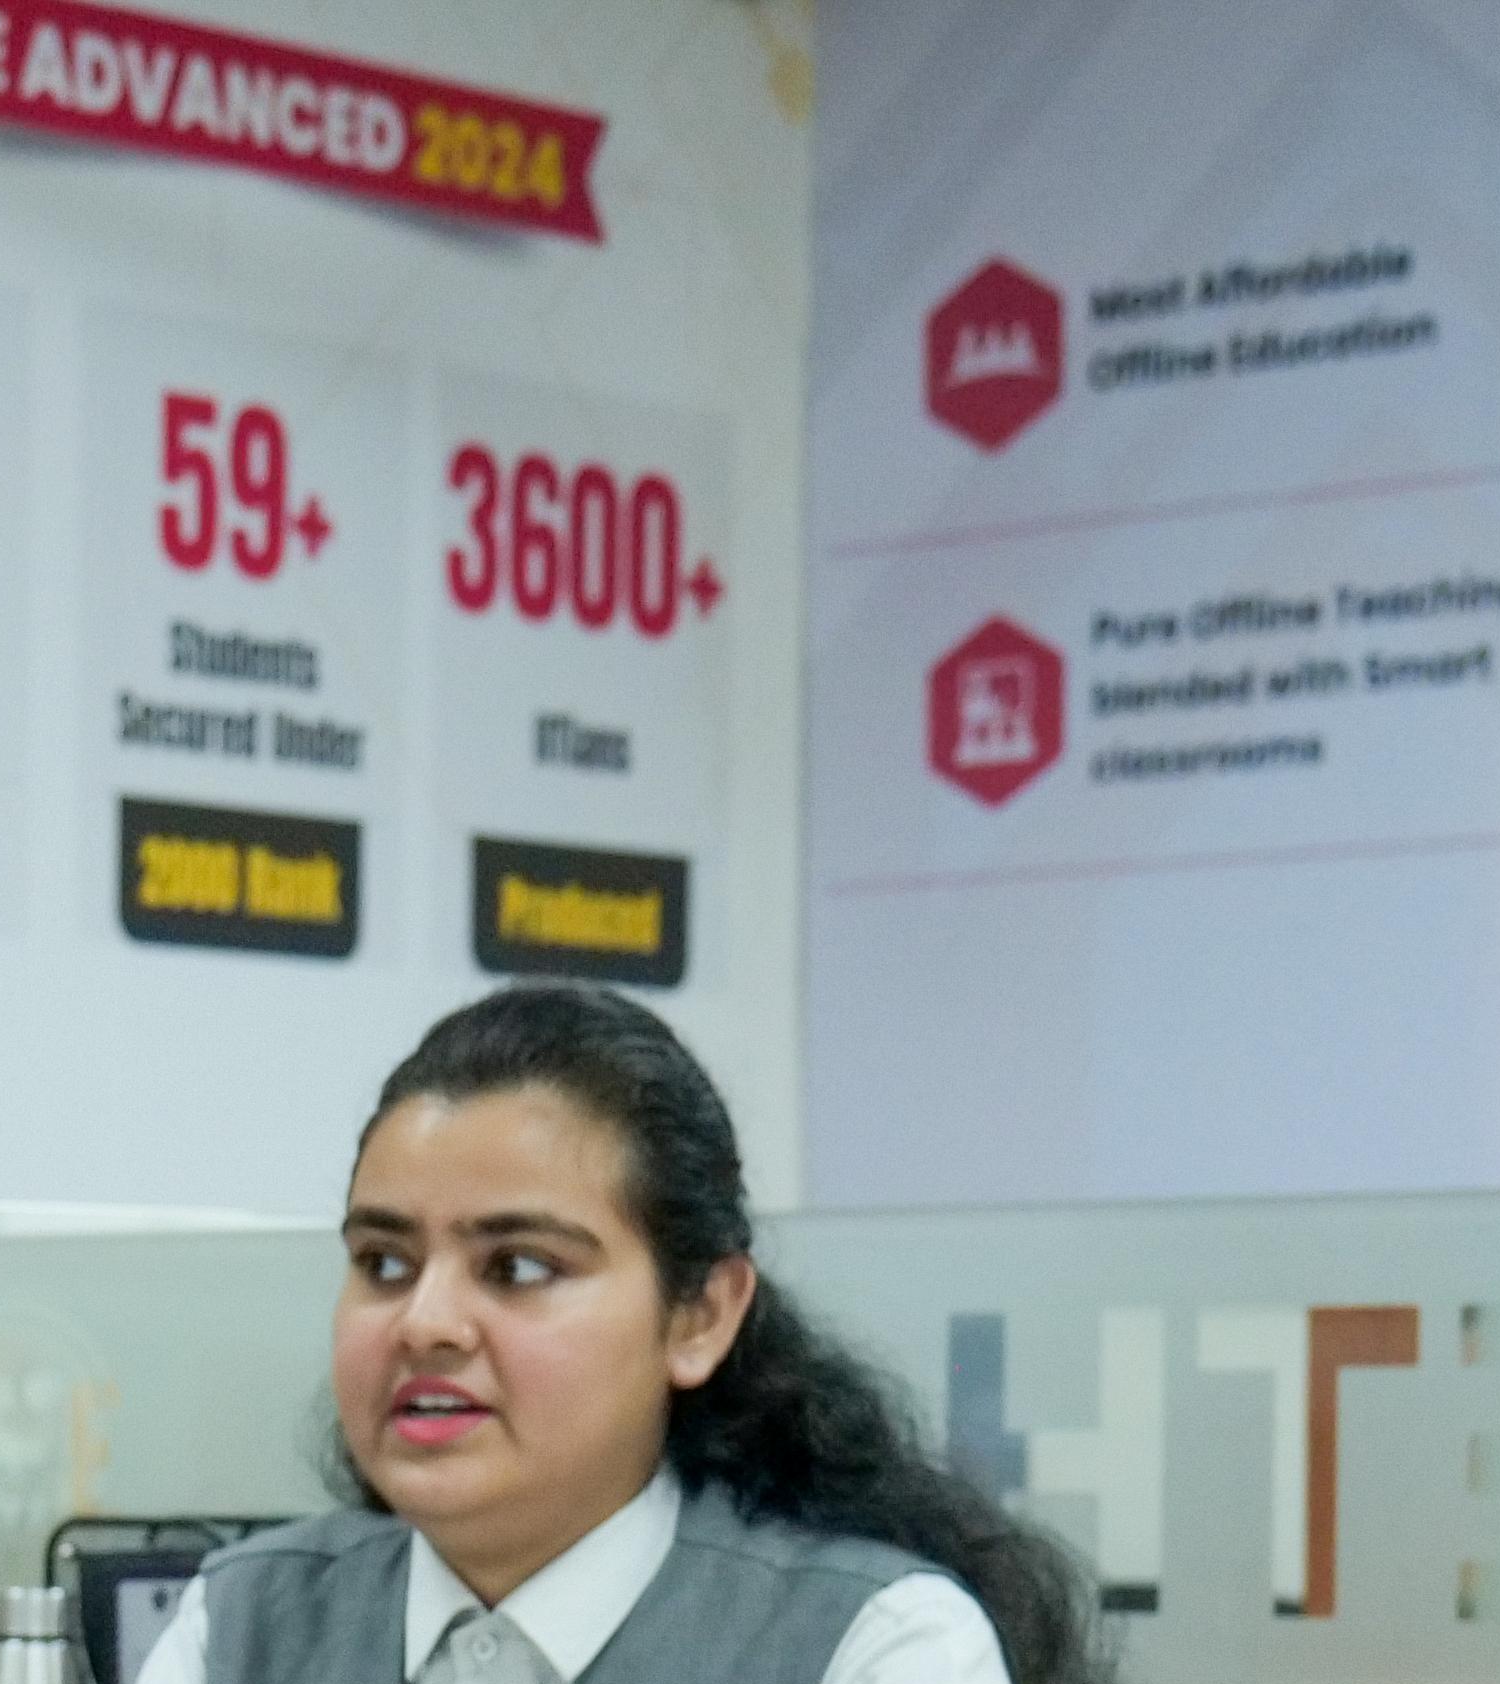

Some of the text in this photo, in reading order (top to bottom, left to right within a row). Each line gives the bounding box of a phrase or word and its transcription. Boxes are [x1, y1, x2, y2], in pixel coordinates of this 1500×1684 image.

[21, 25, 404, 171] ADVANCED
[412, 107, 566, 207] 2024
[1089, 243, 1414, 322] Most Affordable
[1087, 312, 1438, 391] Offline Education
[159, 393, 333, 579] 59+
[447, 444, 724, 640] 3600+
[170, 620, 320, 692] Students
[1092, 606, 1178, 645] Pure
[1191, 590, 1320, 641] Offline
[1092, 640, 1492, 716] blended with Smart
[118, 690, 365, 770] Secured Under
[1091, 732, 1322, 784] classrooms
[138, 834, 341, 926] 2000 Rank
